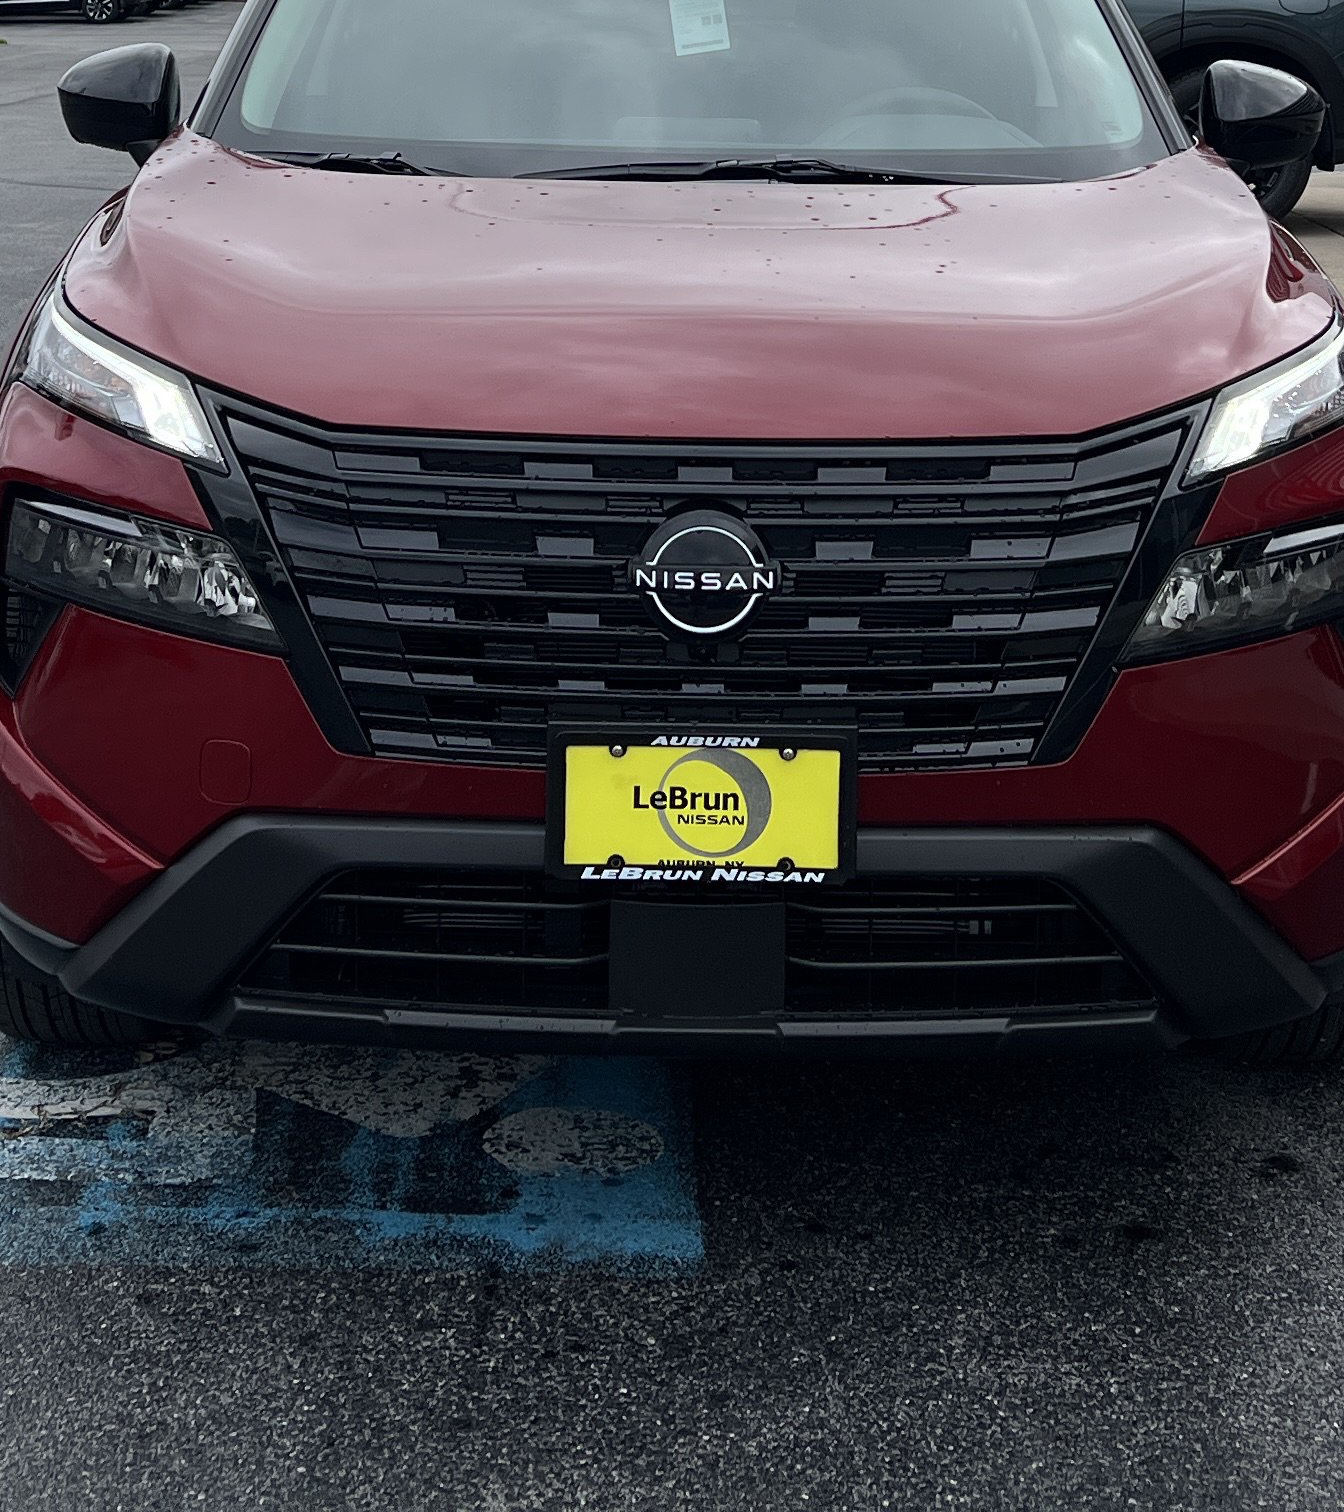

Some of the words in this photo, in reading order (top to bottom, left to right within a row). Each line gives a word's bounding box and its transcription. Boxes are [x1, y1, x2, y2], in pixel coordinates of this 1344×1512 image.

[636, 569, 773, 590] NISSAN
[651, 736, 760, 747] AUBURN
[633, 786, 739, 811] LeBrun
[678, 815, 744, 825] NISSAN
